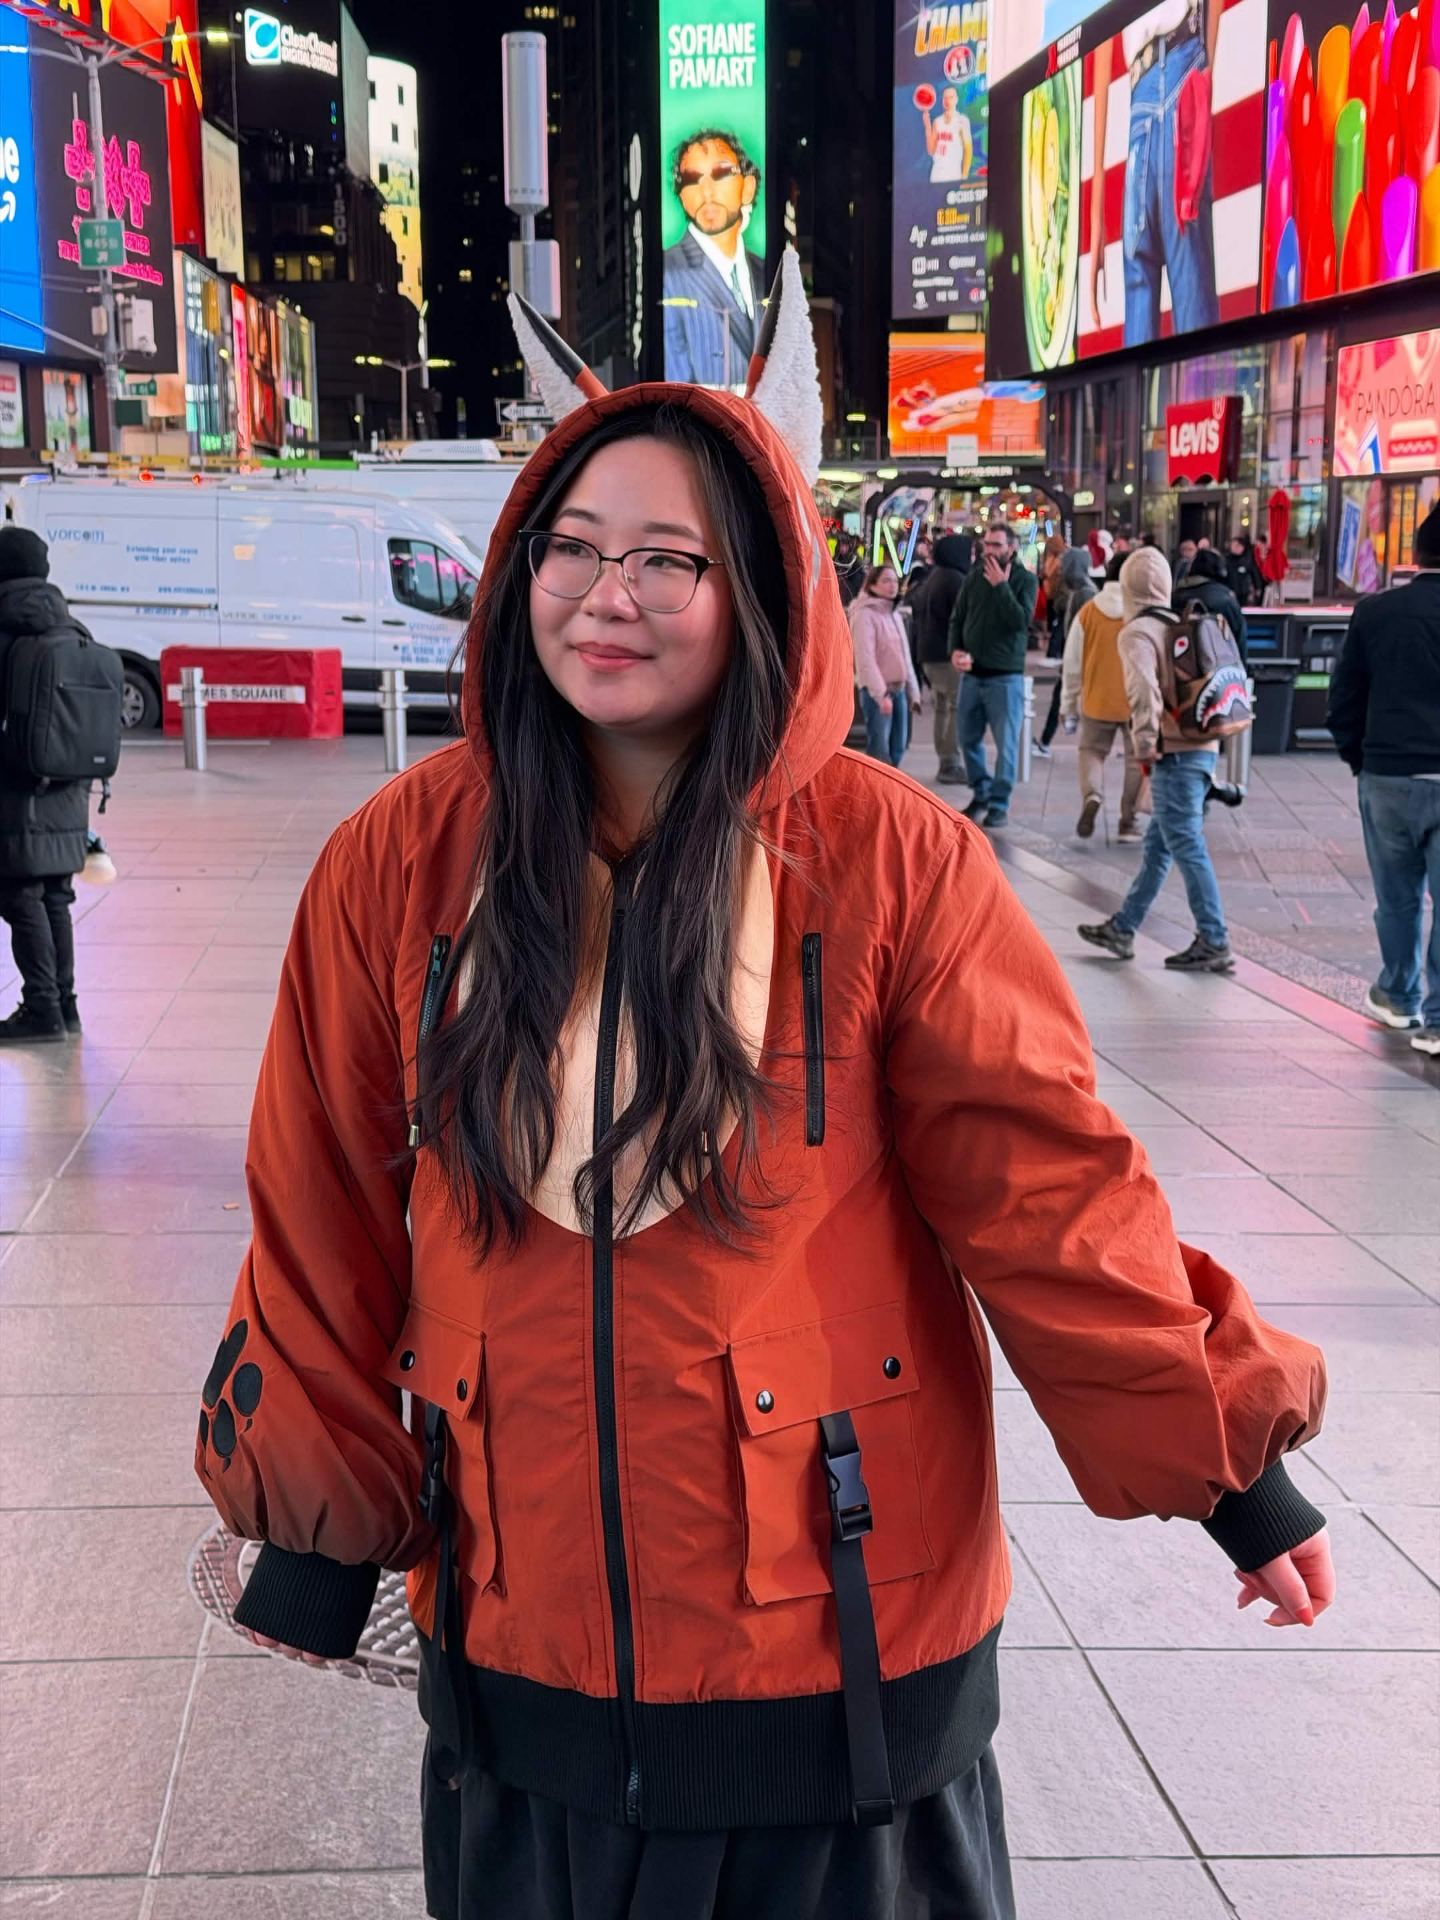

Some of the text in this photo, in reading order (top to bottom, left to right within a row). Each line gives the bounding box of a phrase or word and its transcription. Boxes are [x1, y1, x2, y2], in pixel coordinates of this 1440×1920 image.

[668, 23, 756, 56] SOFIANE
[669, 56, 757, 89] PAMART
[1356, 381, 1437, 423] PANDORA
[231, 687, 287, 701] SQUARE
